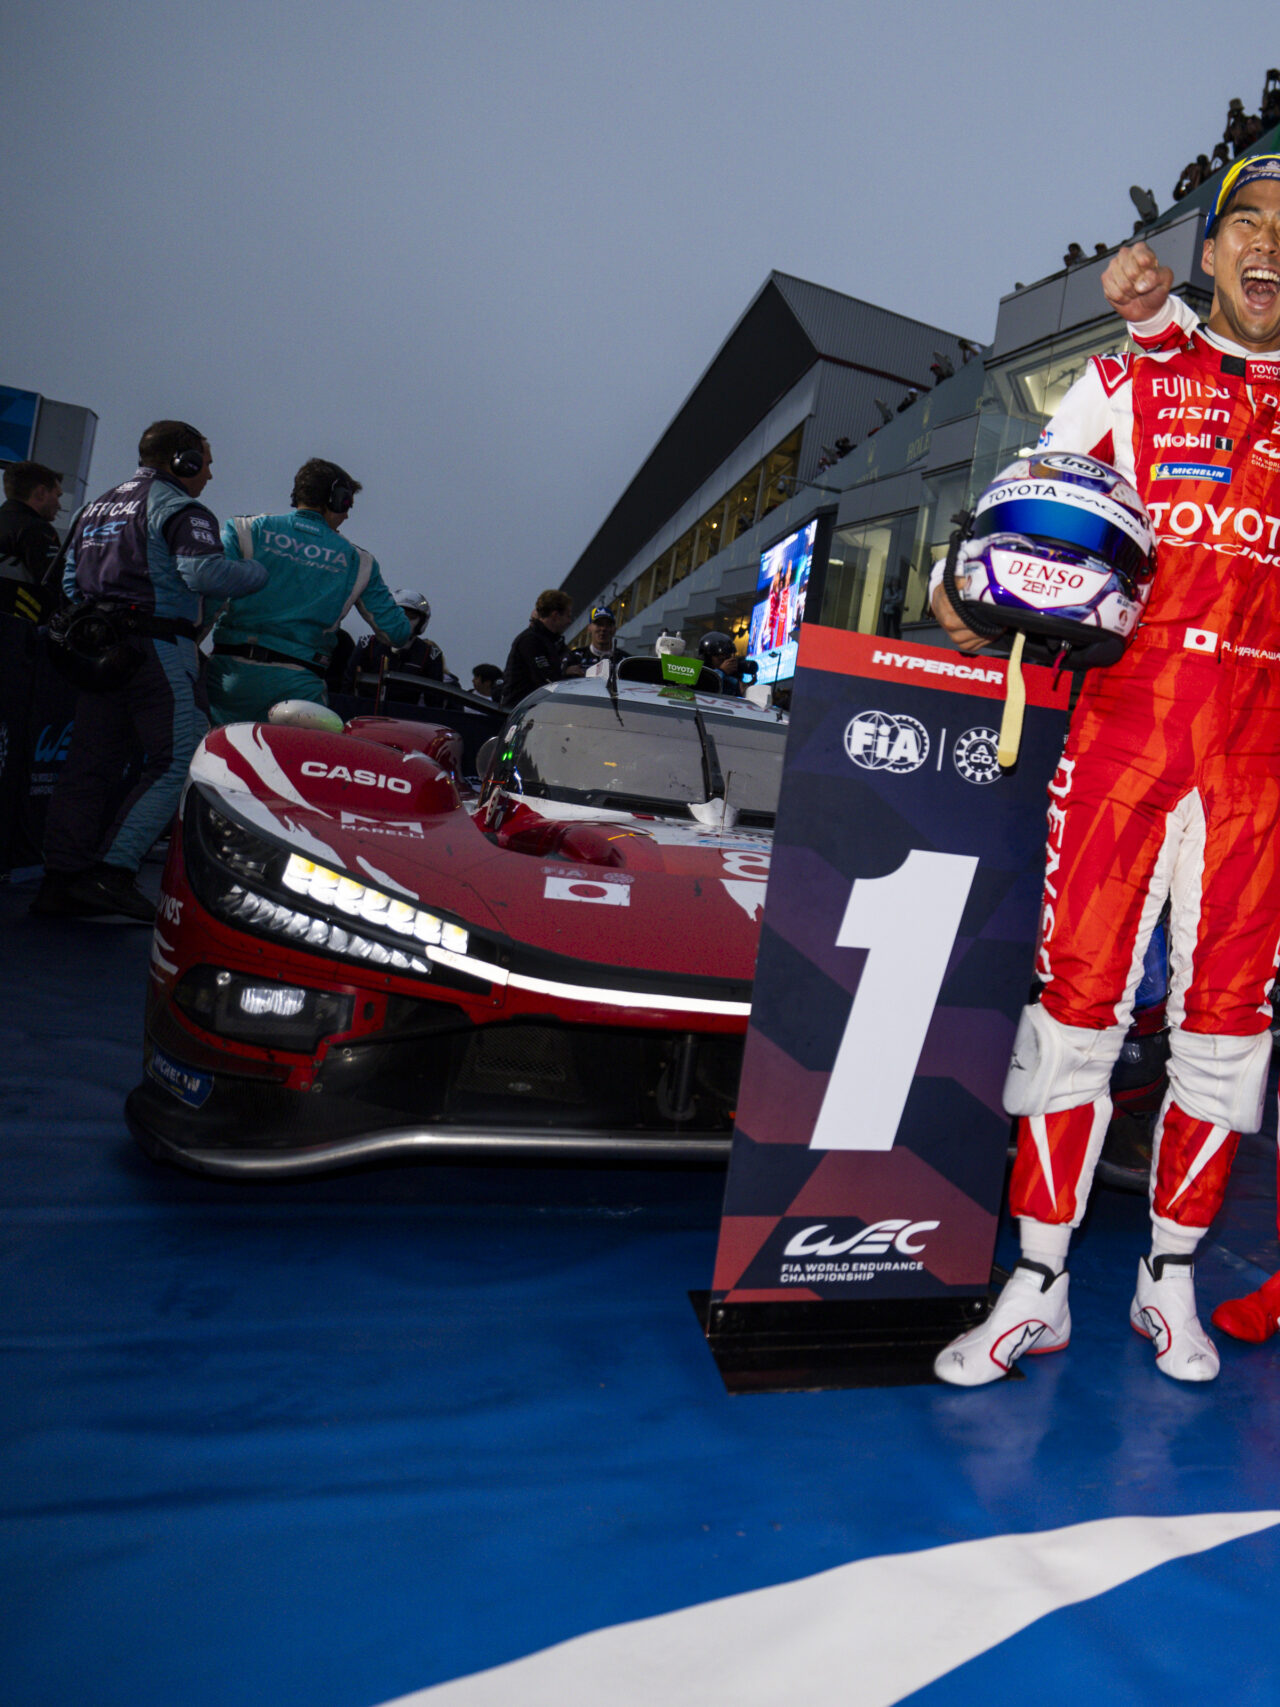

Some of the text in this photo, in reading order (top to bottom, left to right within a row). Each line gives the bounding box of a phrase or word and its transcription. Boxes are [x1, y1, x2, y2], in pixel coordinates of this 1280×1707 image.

[1153, 432, 1212, 449] Mobil
[1043, 456, 1100, 475] Arai
[1171, 467, 1225, 478] MICHELIN
[988, 484, 1057, 504] TOYOTA
[1059, 492, 1144, 536] RACING
[262, 528, 348, 568] TOYOTA
[1008, 560, 1084, 589] DENSO
[1021, 579, 1063, 599] ZENT
[667, 663, 695, 674] TOYOTA
[871, 650, 1004, 685] HYPERCAR
[300, 761, 412, 794] CASIO
[341, 824, 425, 839] MARELLI
[722, 851, 771, 880] 8
[808, 849, 980, 1151] 1
[783, 1219, 942, 1257] WEC
[780, 1271, 875, 1283] CHAMPIONSHIP
[781, 1261, 924, 1273] FIA WORLD ENDURANCE
